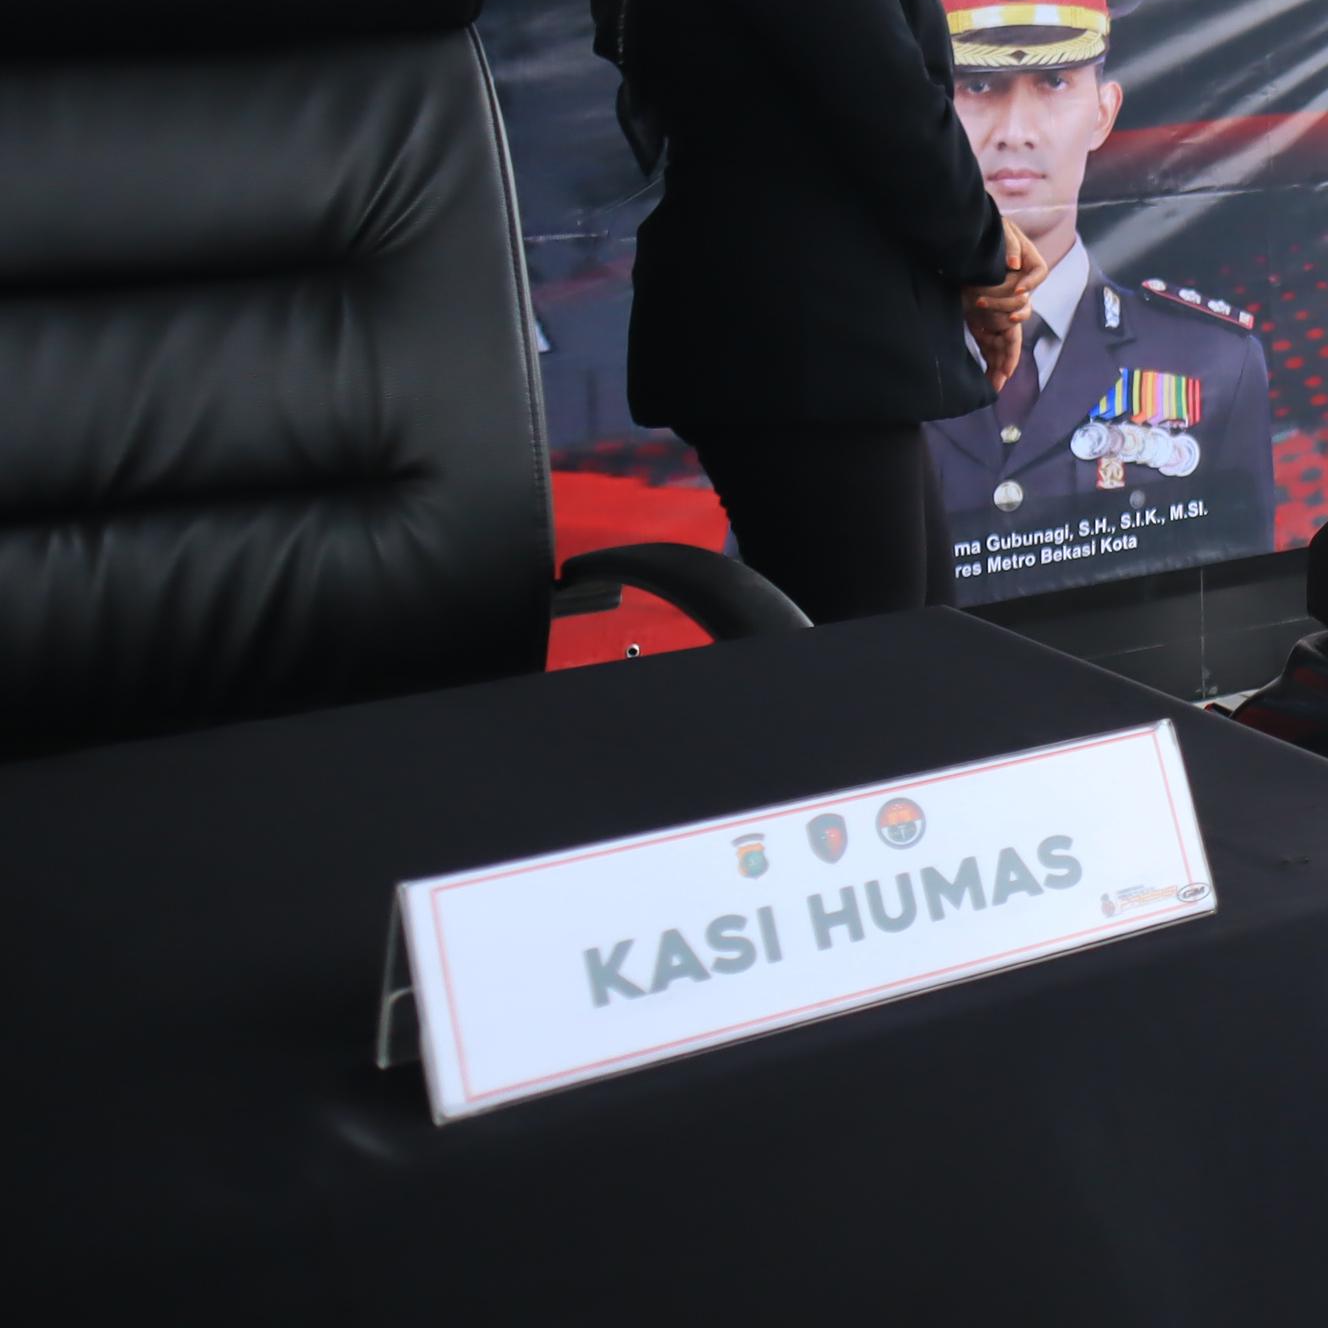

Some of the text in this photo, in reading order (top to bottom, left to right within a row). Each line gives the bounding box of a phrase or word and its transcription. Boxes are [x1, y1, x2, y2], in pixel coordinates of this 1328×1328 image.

[1078, 516, 1116, 537] S.H.,
[1120, 508, 1165, 529] S.I.K.,
[955, 534, 1138, 579] res Metro Bekasi Kota
[584, 834, 1083, 1006] KASI HUMAS
